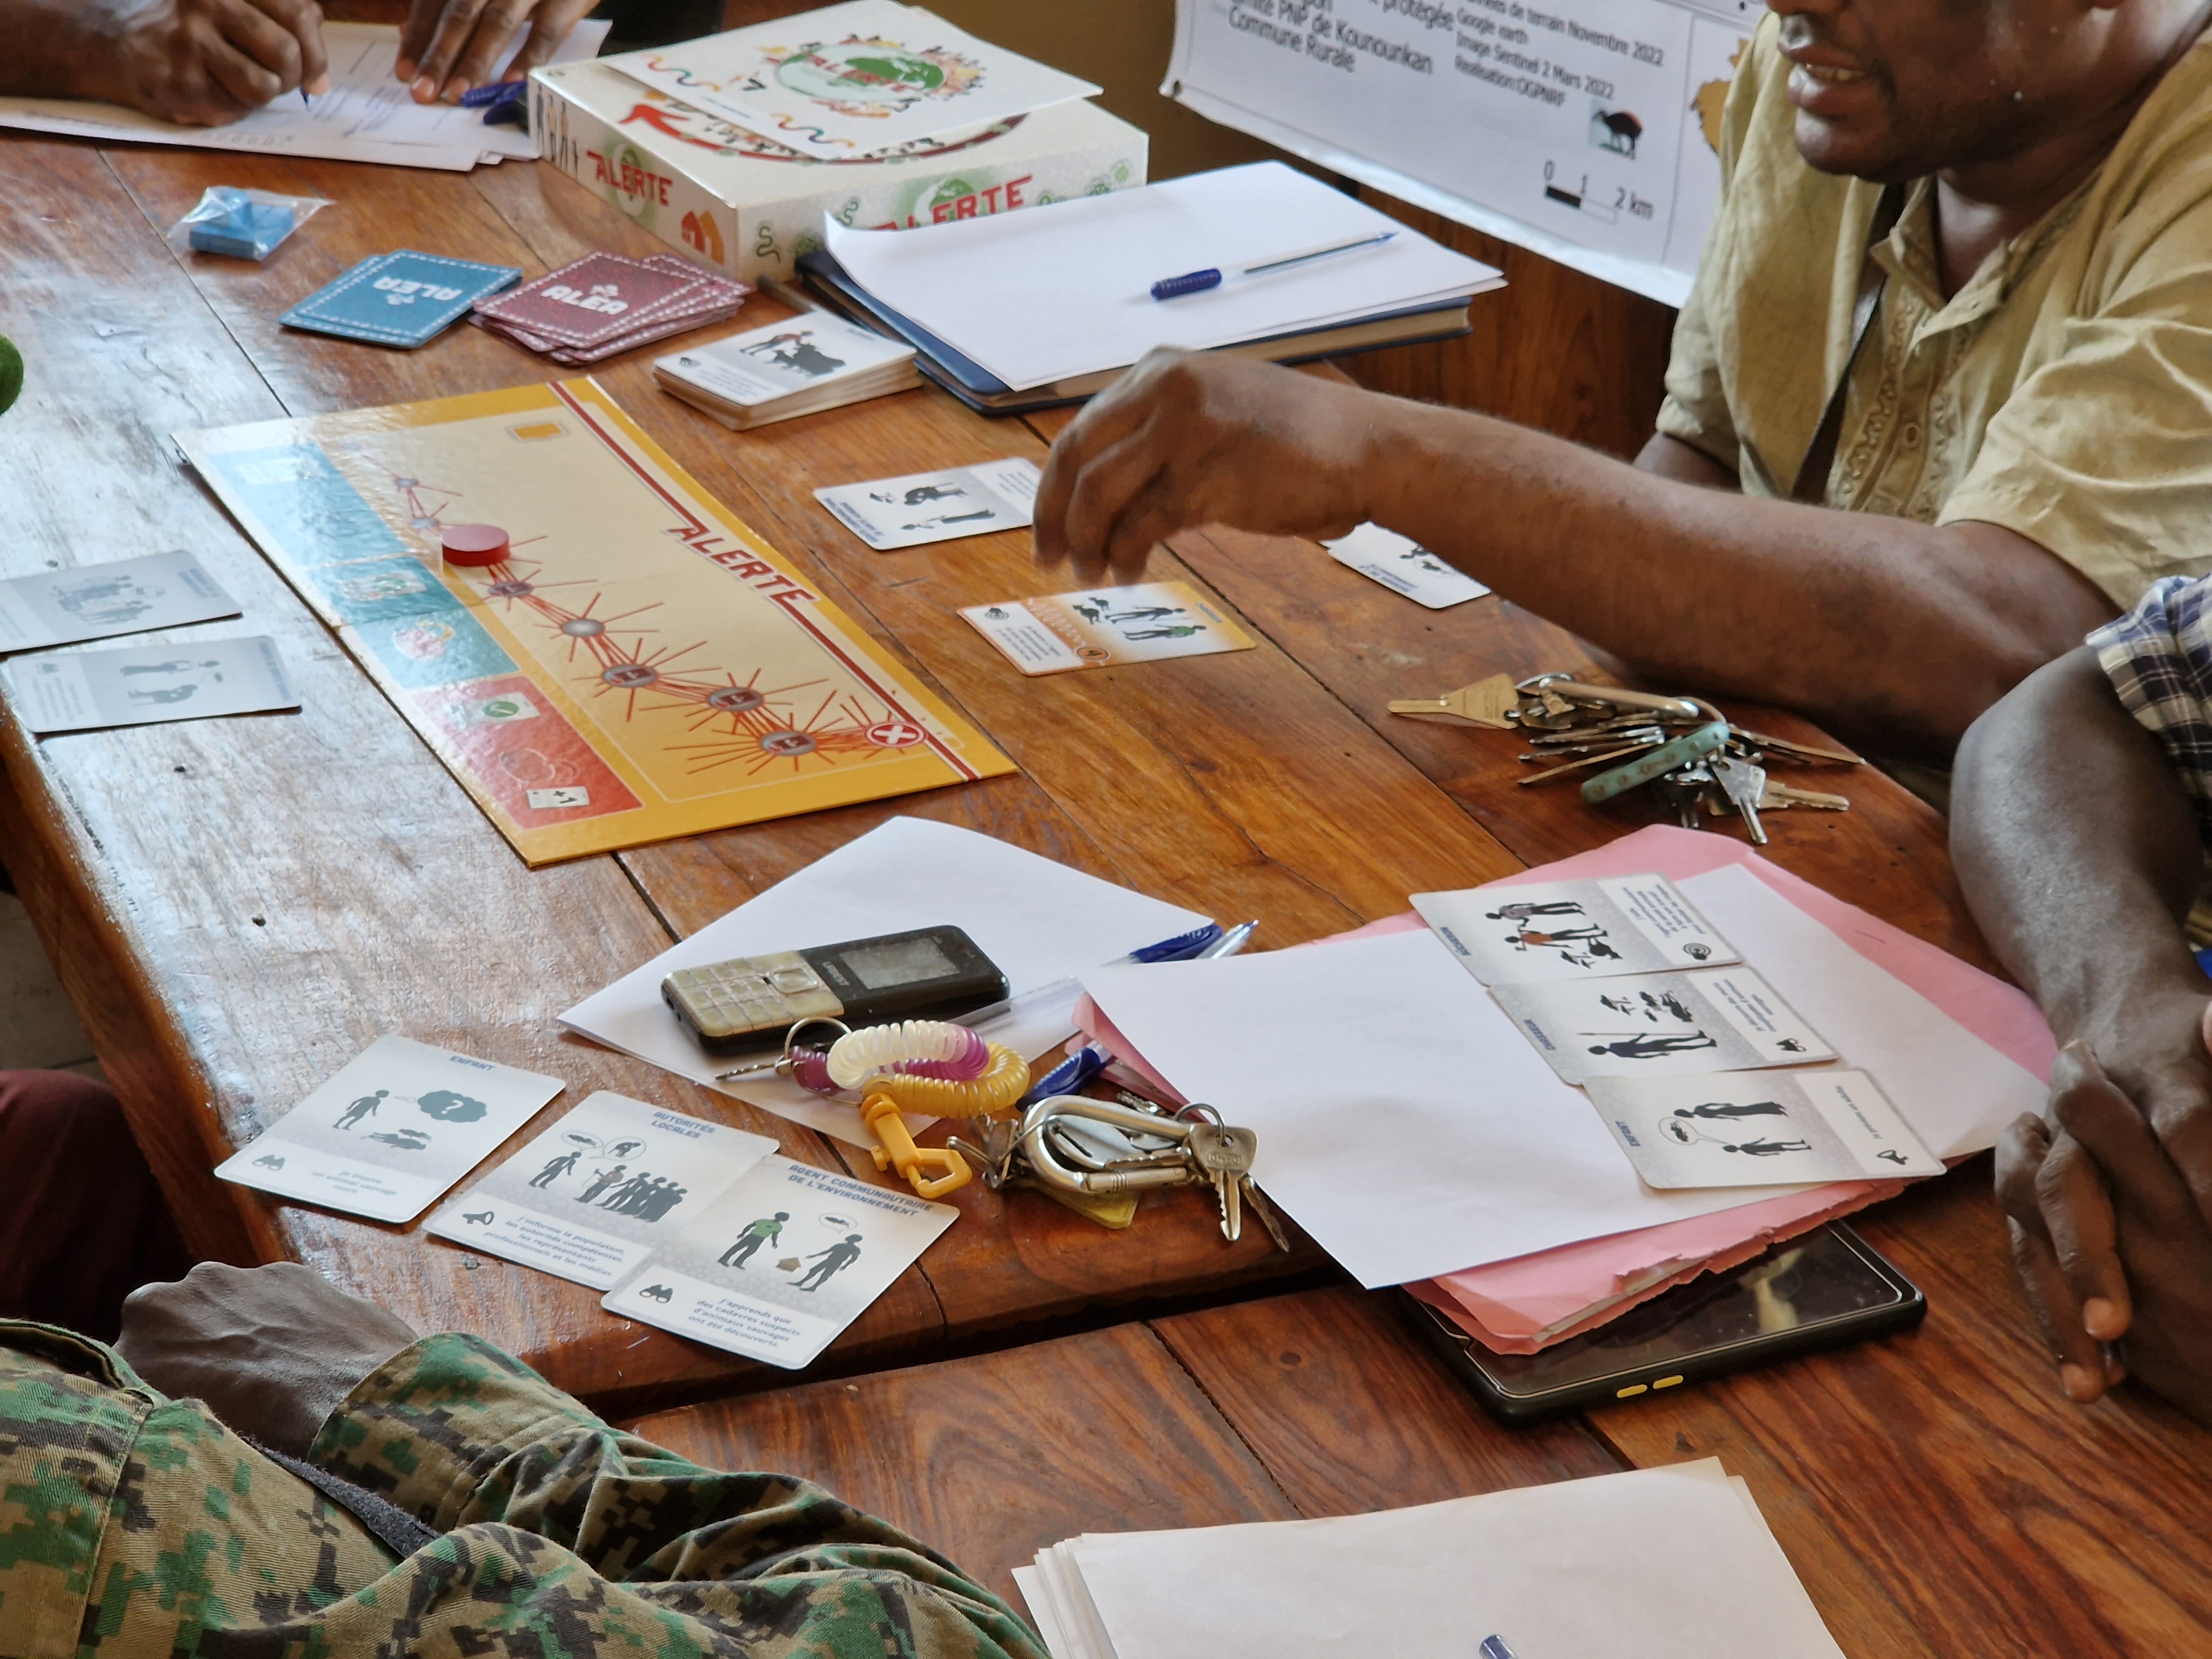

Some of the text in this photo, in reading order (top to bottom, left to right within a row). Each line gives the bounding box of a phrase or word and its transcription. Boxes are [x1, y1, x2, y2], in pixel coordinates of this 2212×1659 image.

[1229, 4, 1355, 72] Commune Rurale
[1312, 12, 1332, 38] de
[1509, 2, 1525, 20] de
[1527, 8, 1565, 33] terrain
[1567, 20, 1629, 55] Novembre
[1632, 40, 1665, 67] 2022
[1455, 30, 1616, 101] Image Sentinel 2 Mars 2022
[586, 150, 674, 207] ALERTE
[1543, 159, 1655, 221] 0 1 2 km
[869, 174, 1033, 230] ERTE
[372, 276, 464, 302] ALEA
[540, 284, 630, 316] ALEA
[665, 519, 816, 604] ALERTE
[1524, 1019, 1555, 1050] CHASSEUR
[449, 1055, 494, 1071] ENFANT
[651, 1120, 701, 1138] LOCALES
[653, 1112, 715, 1133] AUTORITÉS
[1615, 1120, 1640, 1146] ENFANT
[788, 1175, 918, 1215] DE L'ENVIRONNEMENT
[789, 1165, 933, 1211] AGENT COMMUNAUTAIRE
[516, 1216, 561, 1234] J'informe
[519, 1226, 561, 1242] autorités
[483, 1232, 550, 1256] professionnels
[564, 1256, 576, 1265] les
[533, 1239, 596, 1262] représentants
[687, 1316, 705, 1324] ont
[706, 1321, 723, 1329] été
[693, 1308, 789, 1341] d'animaux sauvages
[696, 1300, 800, 1335] des cadavres suspects
[718, 1298, 791, 1324] J'apprends que
